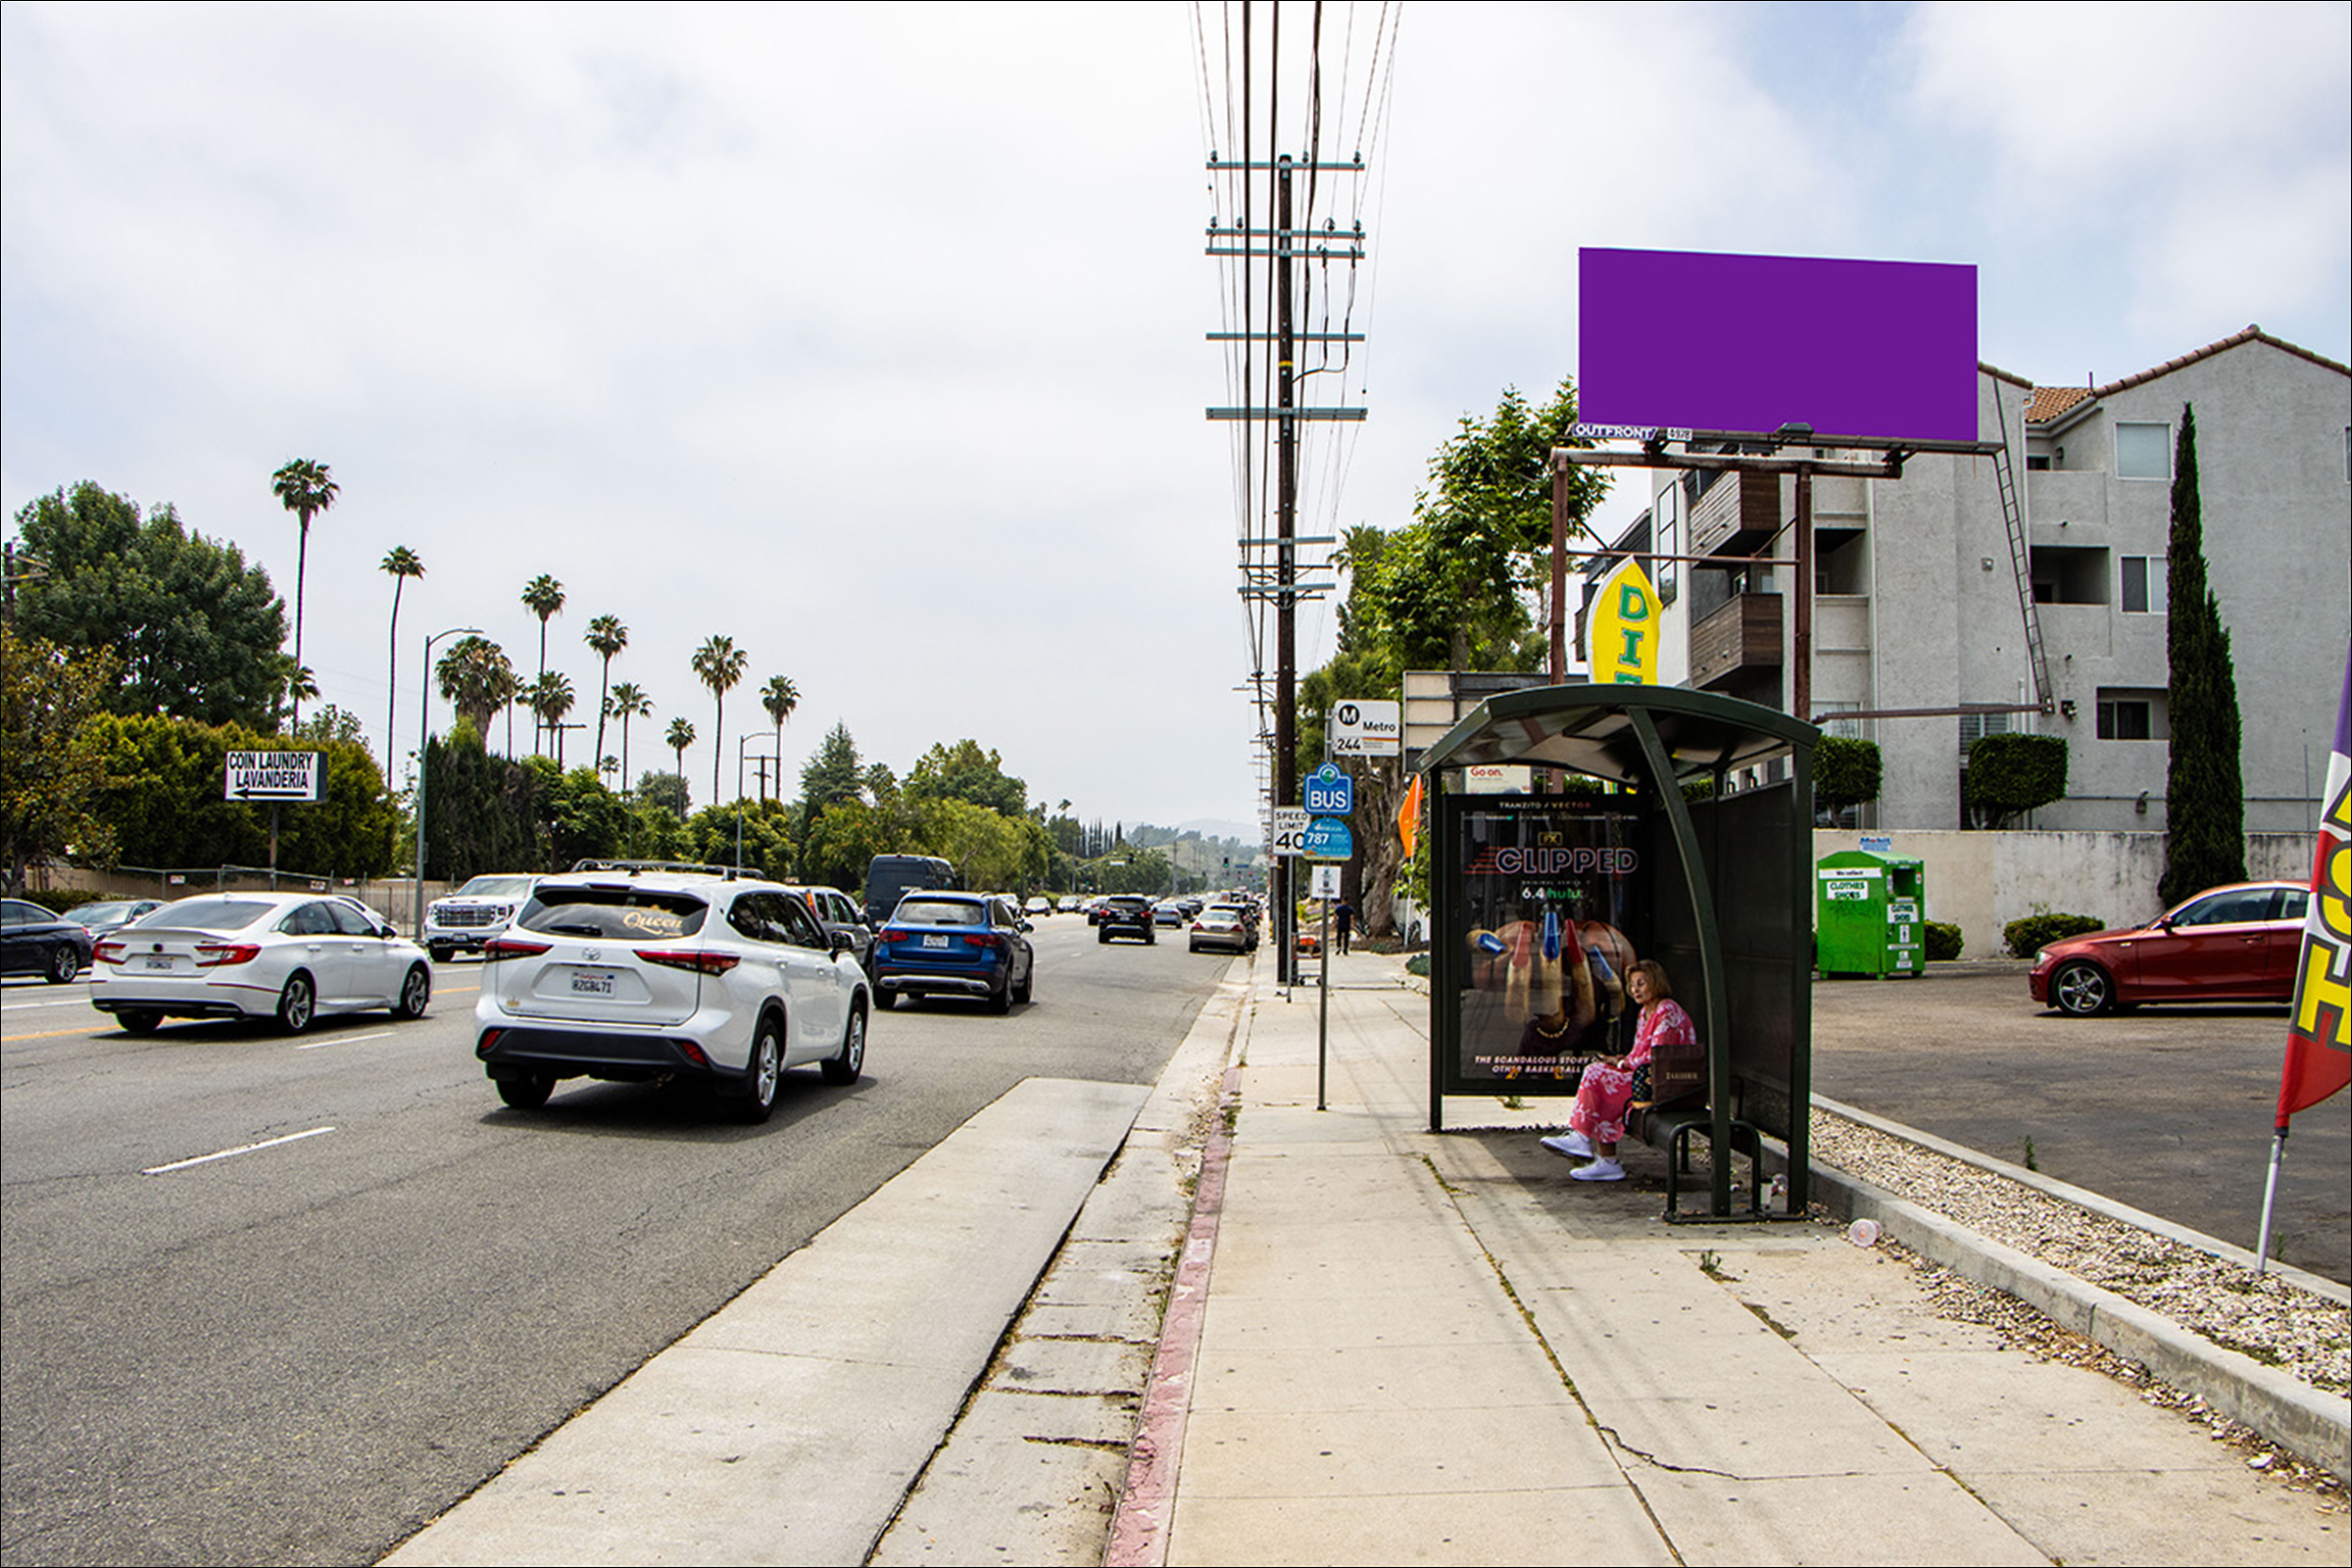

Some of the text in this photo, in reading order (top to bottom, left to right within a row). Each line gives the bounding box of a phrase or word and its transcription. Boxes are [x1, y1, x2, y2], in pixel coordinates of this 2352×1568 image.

[1363, 721, 1396, 732] Metro
[1337, 738, 1361, 751] 244
[228, 752, 313, 770] COIN LAUNDRY
[1470, 766, 1486, 777] Go
[236, 770, 309, 788] LAVANDERIA
[1310, 791, 1347, 808] BUS
[1276, 811, 1308, 821] SPEED
[1275, 831, 1304, 850] 40
[1307, 832, 1330, 845] 787
[1495, 847, 1639, 874] CLIPPED
[1522, 887, 1581, 900] 6.4 hulu
[1494, 1055, 1557, 1064] SCANDALOUS
[1559, 1055, 1589, 1064] STORY
